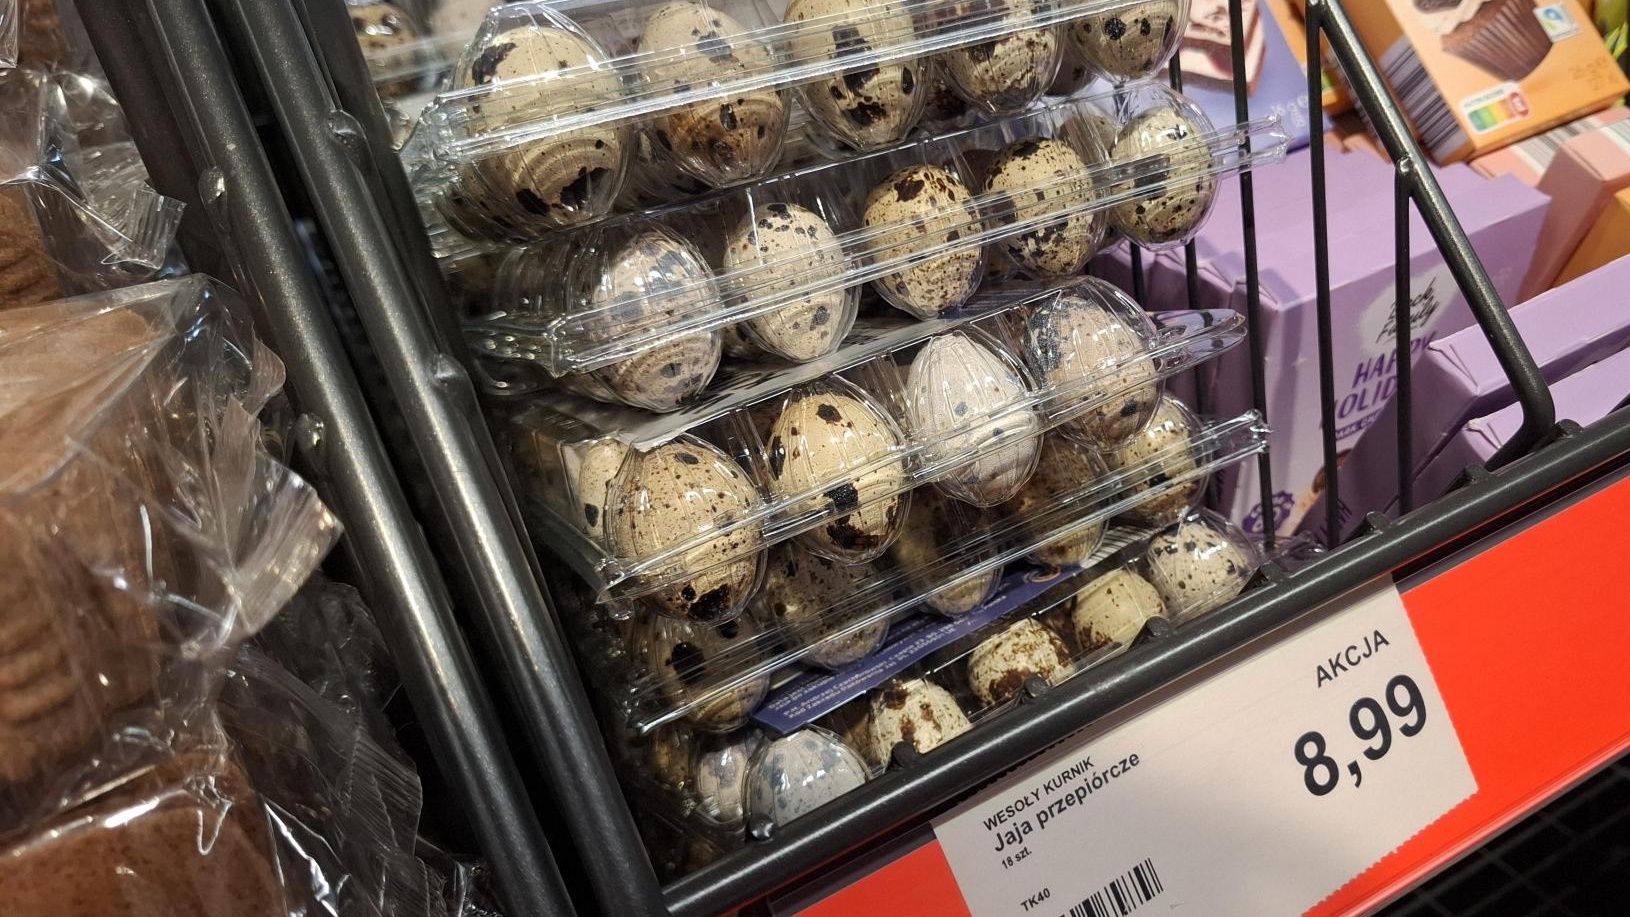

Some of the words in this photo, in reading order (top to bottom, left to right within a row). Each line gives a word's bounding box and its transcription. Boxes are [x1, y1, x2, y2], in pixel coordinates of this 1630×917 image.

[1316, 629, 1390, 688] AKCJA
[1294, 674, 1427, 796] 8,99
[983, 788, 1041, 831] WESOŁY
[1043, 756, 1095, 795] KURNIK
[994, 820, 1034, 852] Jaja
[1036, 753, 1140, 829] przepiórcze
[1001, 856, 1014, 869] 18
[1015, 846, 1032, 862] szt.
[1020, 887, 1051, 912] TK40
